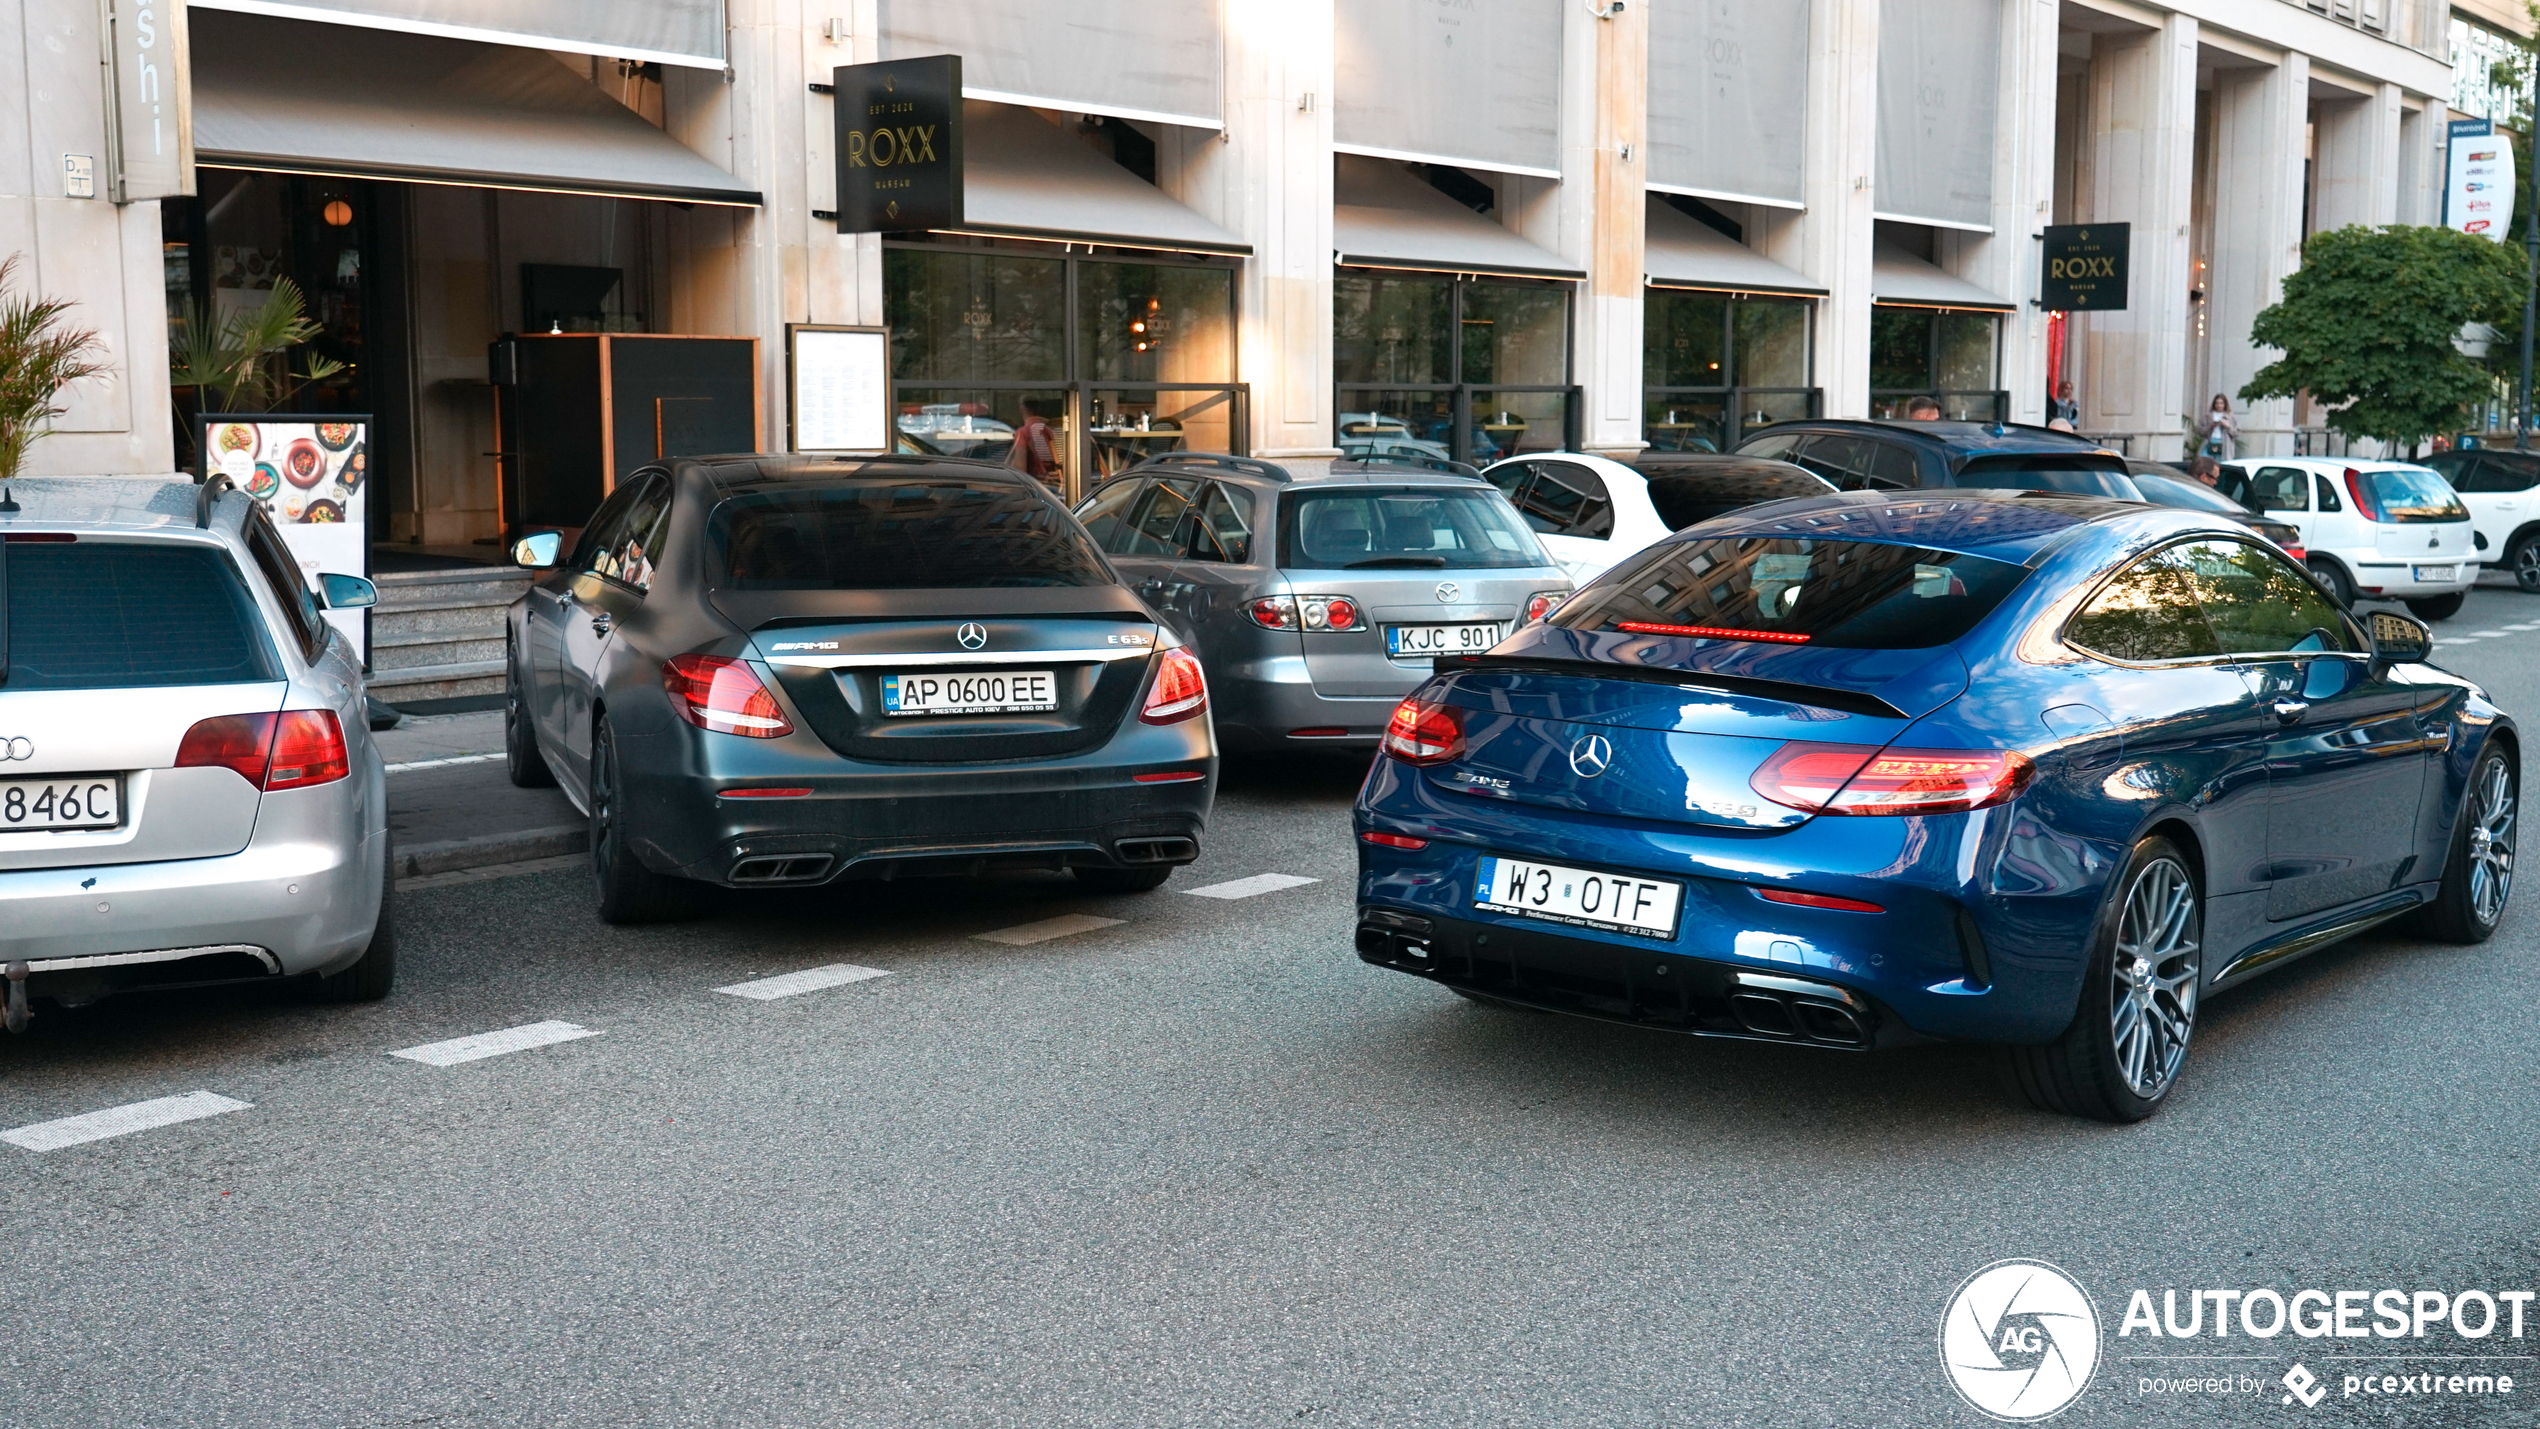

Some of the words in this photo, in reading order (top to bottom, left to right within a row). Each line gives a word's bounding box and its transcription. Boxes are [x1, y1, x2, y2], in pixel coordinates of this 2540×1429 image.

[136, 0, 162, 155] shi
[870, 104, 885, 115] EST
[849, 124, 936, 168] ROXX
[875, 179, 911, 189] WARSAW
[2051, 256, 2115, 279] ROXX
[2463, 437, 2473, 450] P
[1107, 634, 1118, 645] E
[1401, 628, 1445, 650] KJC
[1460, 627, 1494, 648] 901
[788, 642, 839, 651] AMG
[903, 679, 939, 706] AP
[947, 677, 1005, 703] 0600
[1012, 676, 1048, 702] EE
[886, 697, 899, 706] UA
[4, 783, 110, 823] 846C
[1478, 884, 1490, 895] PL
[1508, 864, 1552, 906] W3
[1484, 903, 1520, 915] AMG
[1525, 910, 1565, 923] Performance
[1564, 916, 1586, 926] Center
[1586, 919, 1618, 931] Warszawa
[1629, 926, 1638, 934] 22
